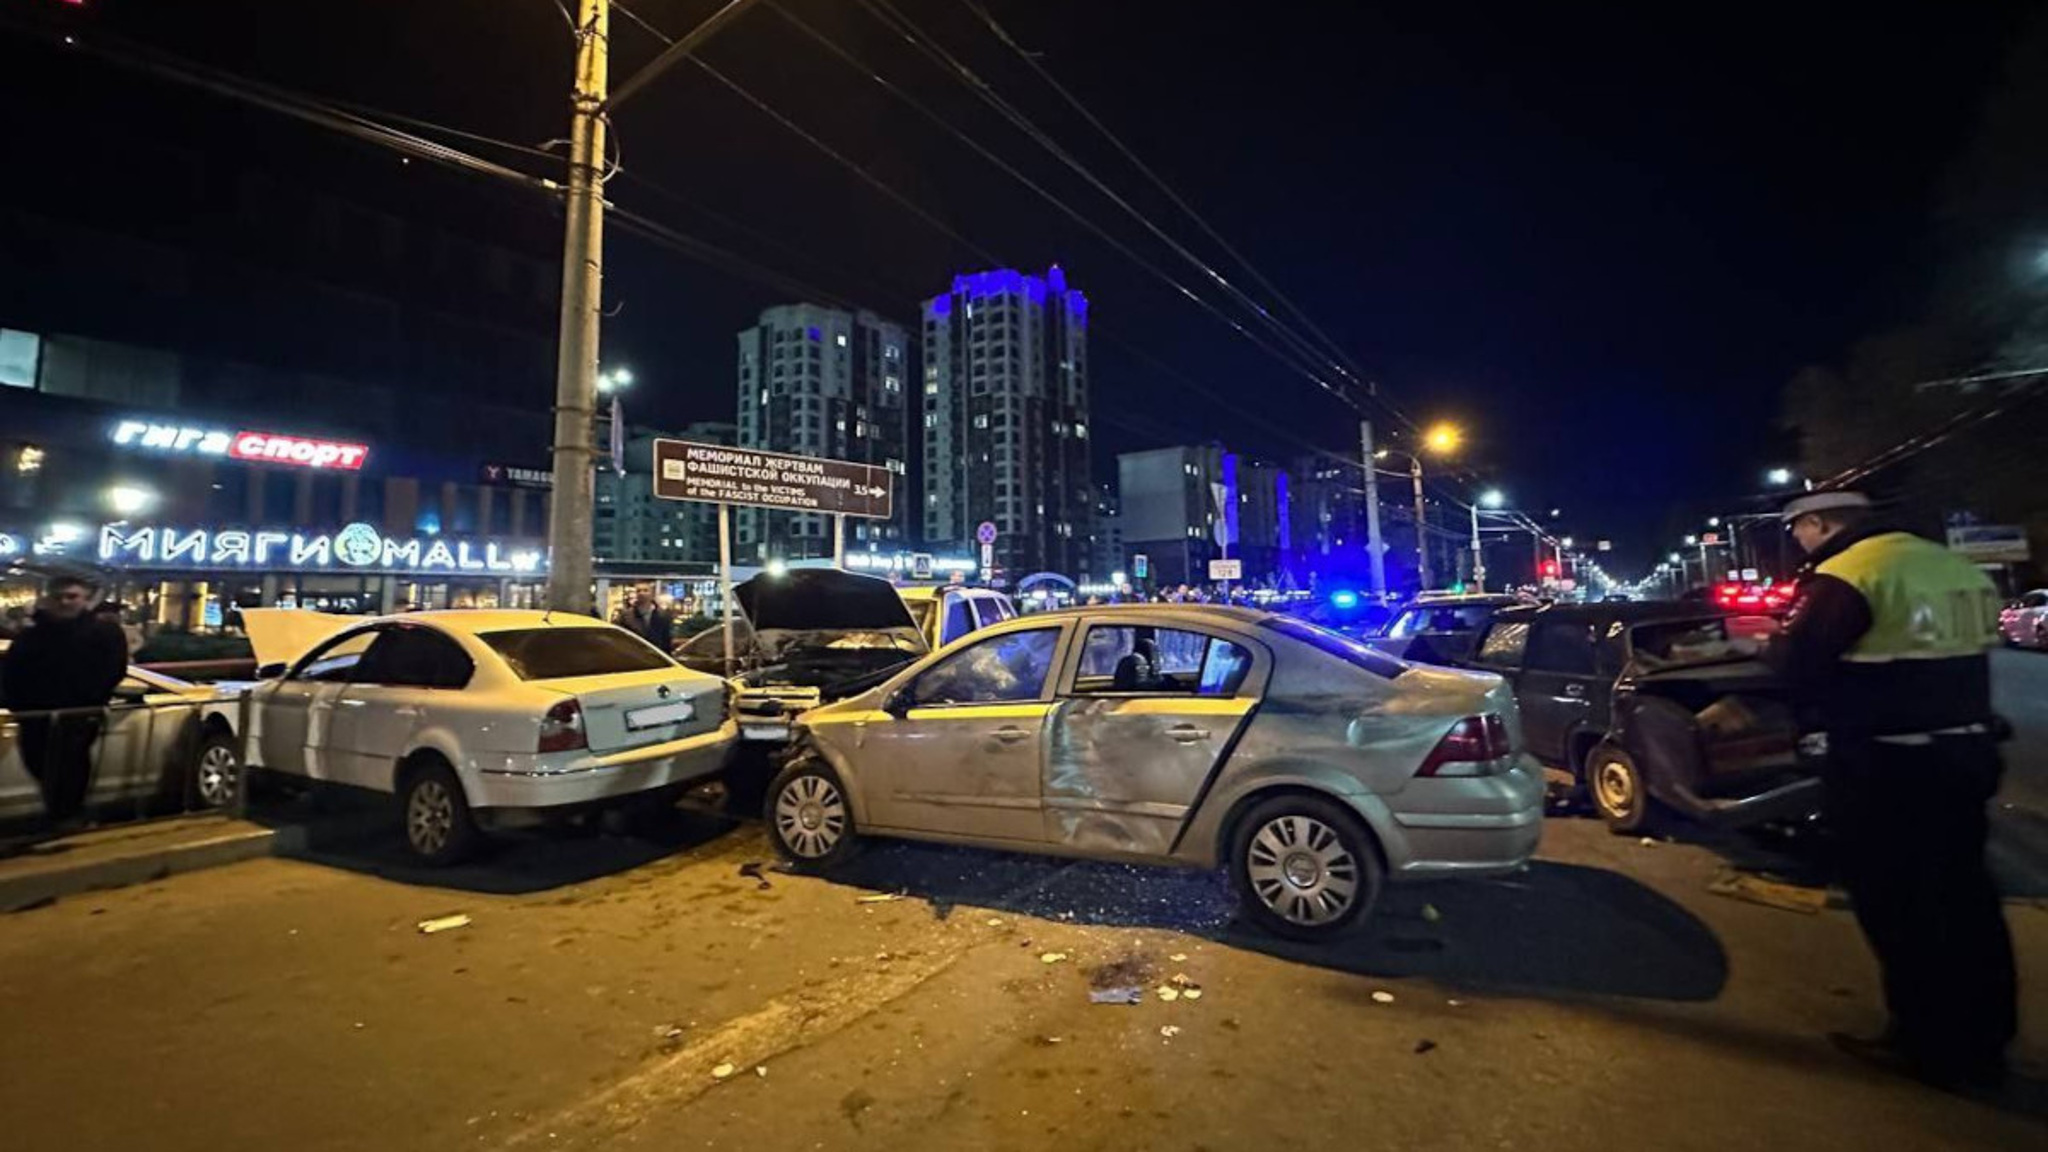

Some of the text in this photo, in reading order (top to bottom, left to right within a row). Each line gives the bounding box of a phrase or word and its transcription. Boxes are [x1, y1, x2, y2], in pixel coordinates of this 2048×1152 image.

[687, 448, 824, 474] МЕМОРИАЛ ЖЕРТВАМ
[686, 478, 739, 490] MEMORIAL
[687, 462, 851, 489] ФАШИСТСКОЙ ОККУПАЦИИ
[687, 488, 818, 507] of the FASCIST OCCUPATION
[99, 525, 330, 565] МИЯГИ
[382, 538, 512, 569] MALL
